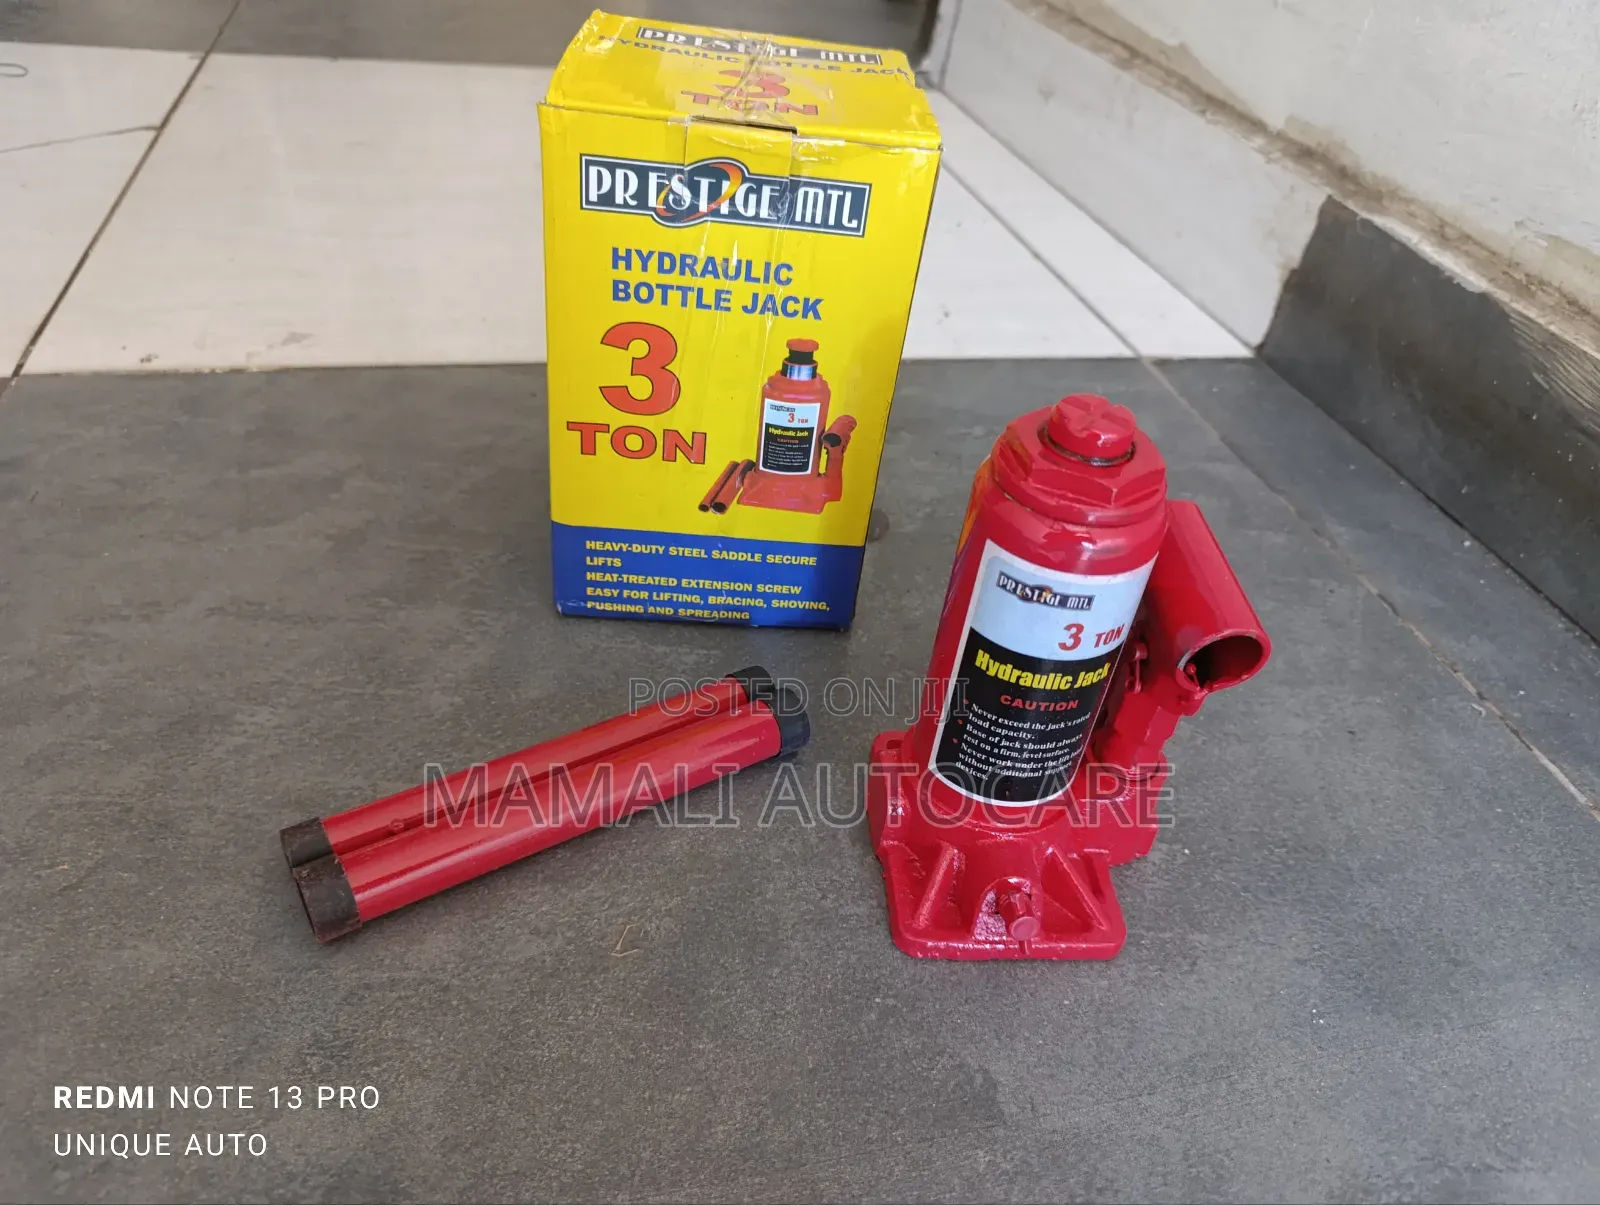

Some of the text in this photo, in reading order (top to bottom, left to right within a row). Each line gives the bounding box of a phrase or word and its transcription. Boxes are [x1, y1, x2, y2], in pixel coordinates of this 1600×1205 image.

[714, 69, 790, 98] 3
[681, 90, 819, 116] TON
[587, 164, 859, 229] PRESTIGE MTL
[611, 246, 793, 286] HYDRAULIC
[612, 279, 824, 321] BOTTLE JACK
[599, 321, 681, 416] 3
[788, 412, 795, 423] 3
[566, 421, 707, 465] TON
[586, 540, 817, 566] HEAVY-DUTY STEEL SADDLE SECURE
[586, 557, 622, 567] LIFTS
[586, 572, 802, 594] HEAT-TREATED EXTENSION SCREW
[998, 574, 1091, 610] PRESTIGE MTL
[586, 587, 830, 612] EASY FOR LIFTING, BRACING, SHOVING,
[587, 602, 750, 620] PUSHING AND SPREADING
[1058, 623, 1125, 651] 3 TON
[974, 649, 1112, 690] Hydraulic Jack
[971, 703, 998, 721] Never
[998, 717, 1030, 730] exceed
[1046, 720, 1073, 731] jack's
[1000, 695, 1079, 712] CAUTION
[966, 724, 987, 739] Base
[988, 735, 1000, 744] of
[999, 738, 1022, 749] jack
[1022, 741, 1056, 750] should
[968, 713, 1035, 740] load capacity.
[961, 742, 987, 760] Never
[988, 756, 1014, 768] work
[1014, 761, 1044, 769] under
[963, 733, 979, 747] rest
[980, 742, 991, 751] on
[1021, 752, 1043, 760] level
[955, 761, 989, 781] devices.
[958, 752, 993, 772] without
[994, 767, 1042, 778] additional
